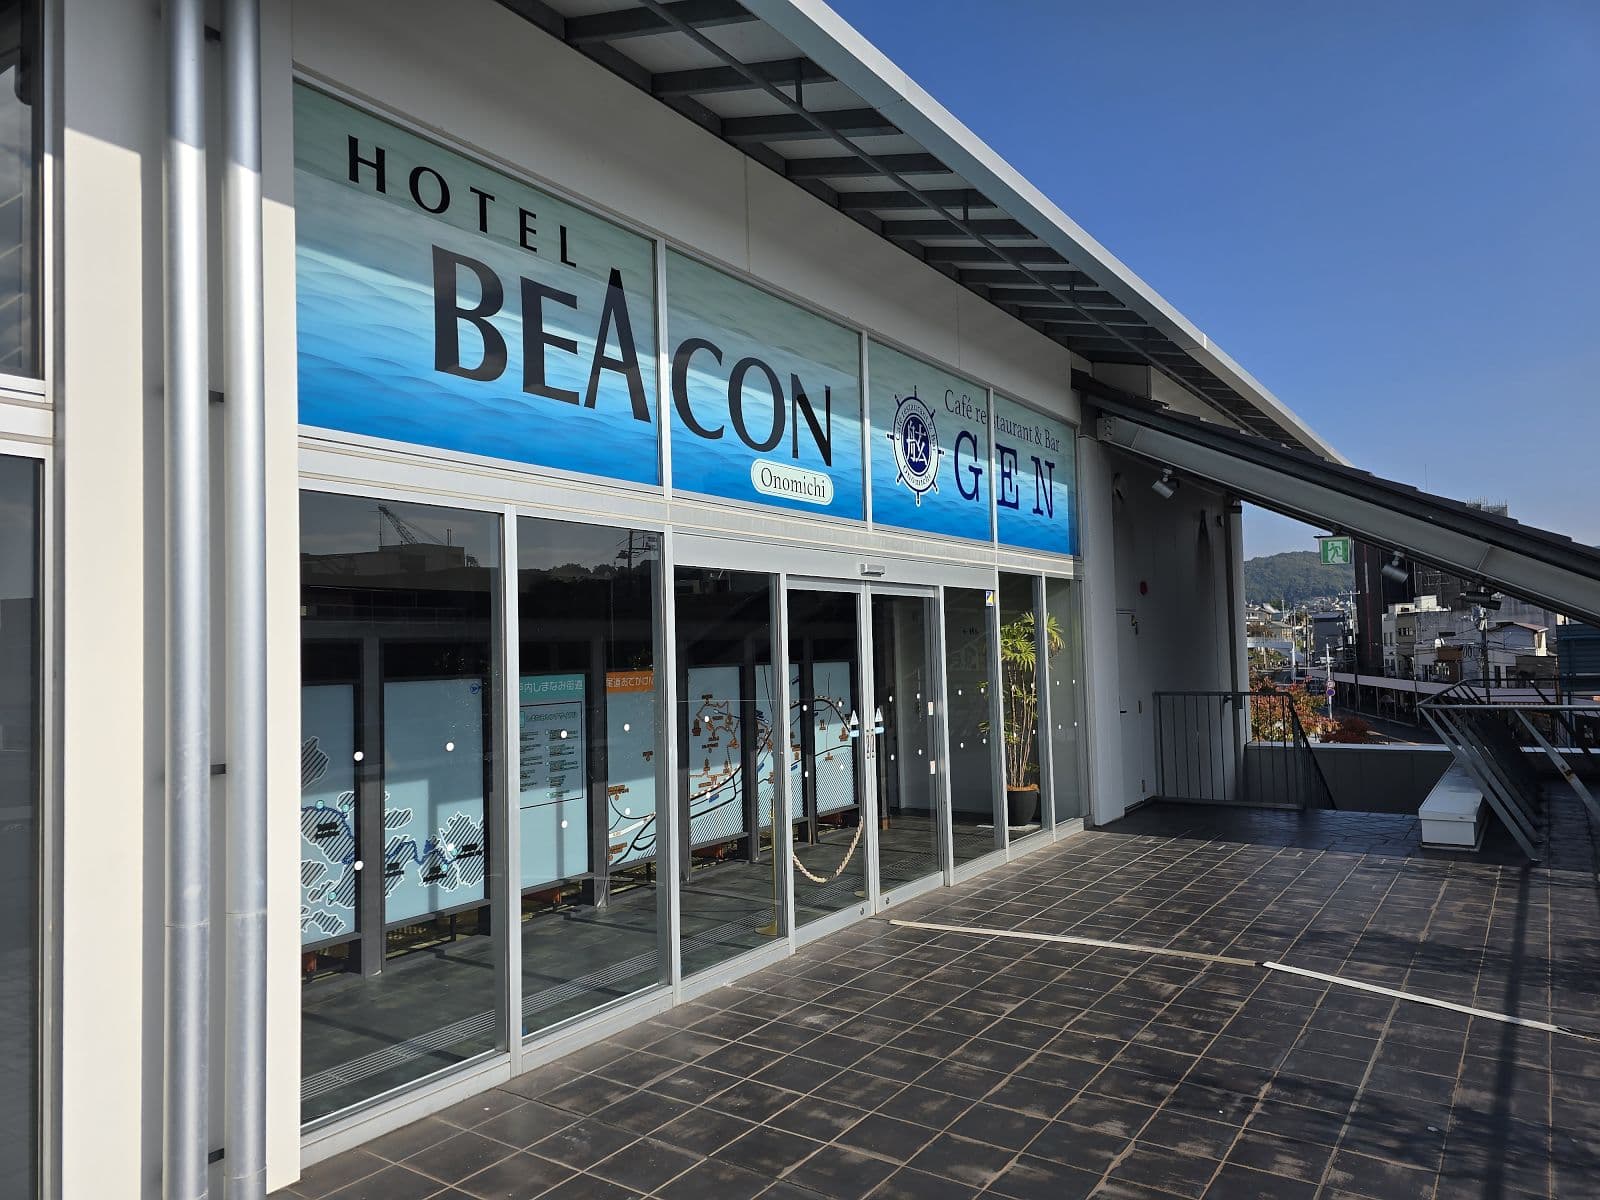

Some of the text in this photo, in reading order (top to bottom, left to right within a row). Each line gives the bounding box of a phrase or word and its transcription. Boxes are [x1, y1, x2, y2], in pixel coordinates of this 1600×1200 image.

[347, 133, 577, 268] HOTEL
[431, 244, 832, 467] BEACON
[944, 389, 1060, 452] Café retaurant & Bar
[760, 467, 826, 498] Onomichi
[953, 430, 1056, 519] GEN
